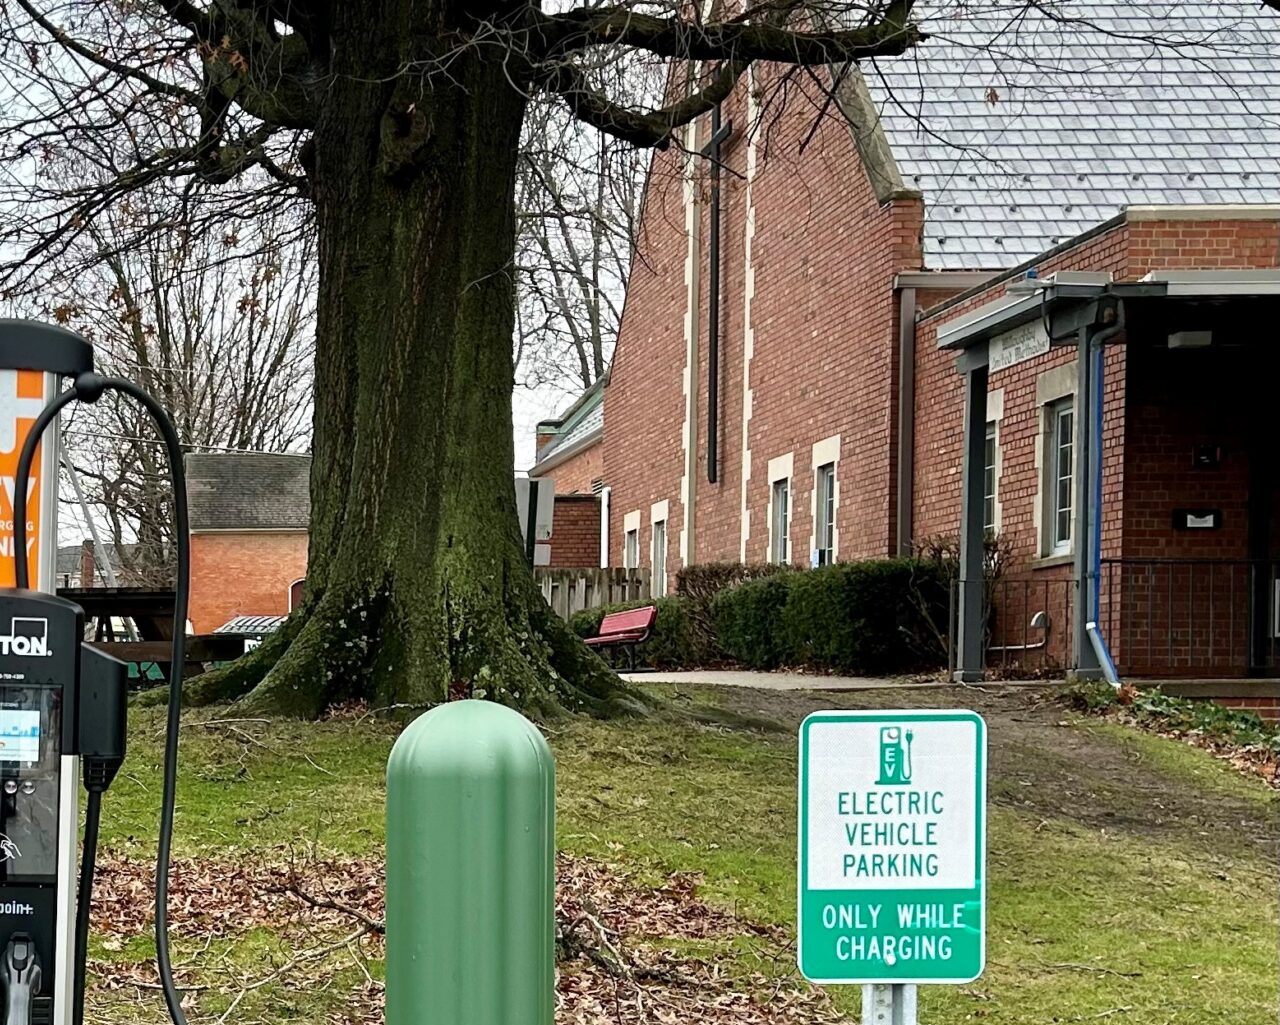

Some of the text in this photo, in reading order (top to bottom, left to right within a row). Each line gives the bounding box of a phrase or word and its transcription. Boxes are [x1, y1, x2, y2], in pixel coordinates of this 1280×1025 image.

[838, 791, 945, 815] ELECTRIC
[845, 822, 938, 846] VEHICLE
[843, 853, 939, 877] PARKING
[822, 903, 966, 929] ONLY WHILE
[836, 935, 953, 960] CHARGING
